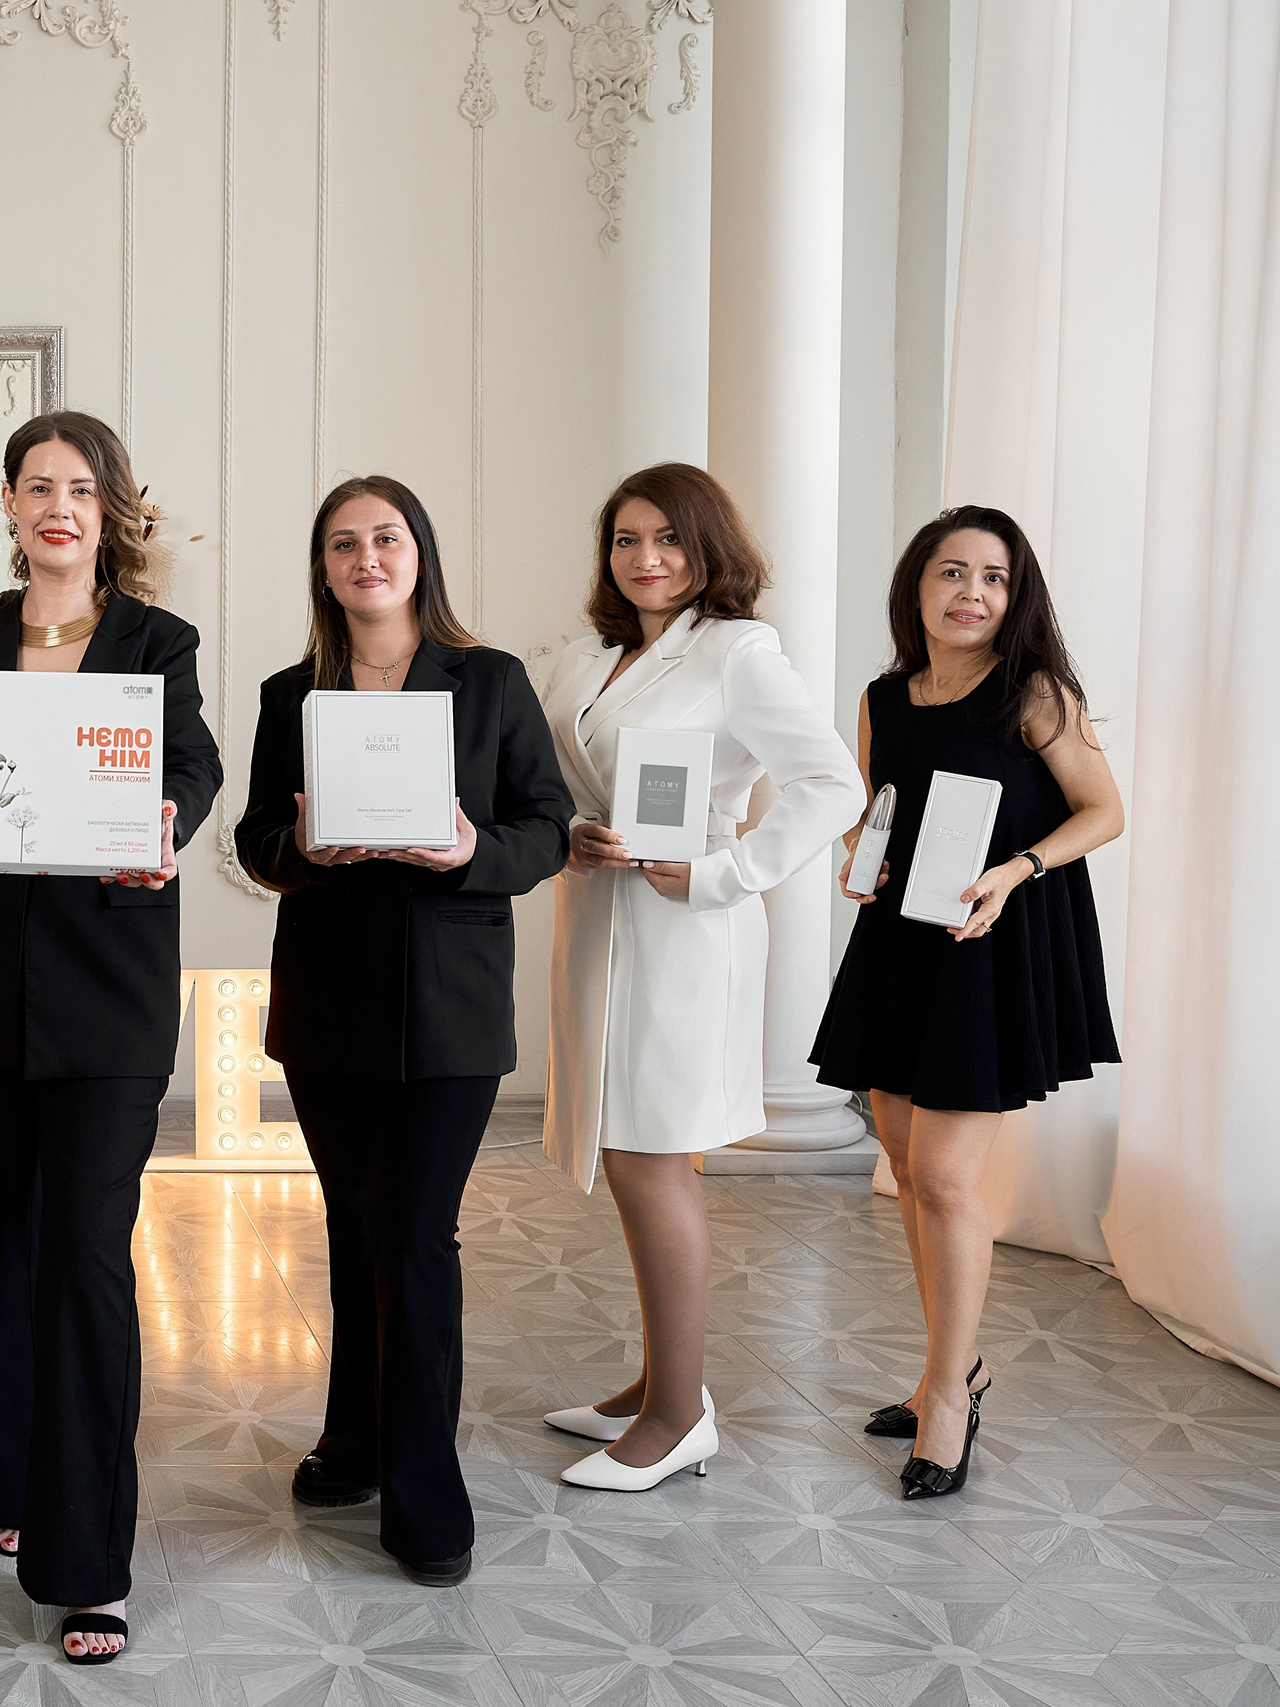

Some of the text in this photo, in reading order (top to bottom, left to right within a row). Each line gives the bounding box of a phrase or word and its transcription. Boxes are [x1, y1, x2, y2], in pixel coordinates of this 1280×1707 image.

[76, 726, 153, 749] HEMO
[98, 749, 151, 768] HIM
[89, 774, 151, 783] АТОМИ ХЕМОХИМ
[646, 780, 680, 789] ATOMY
